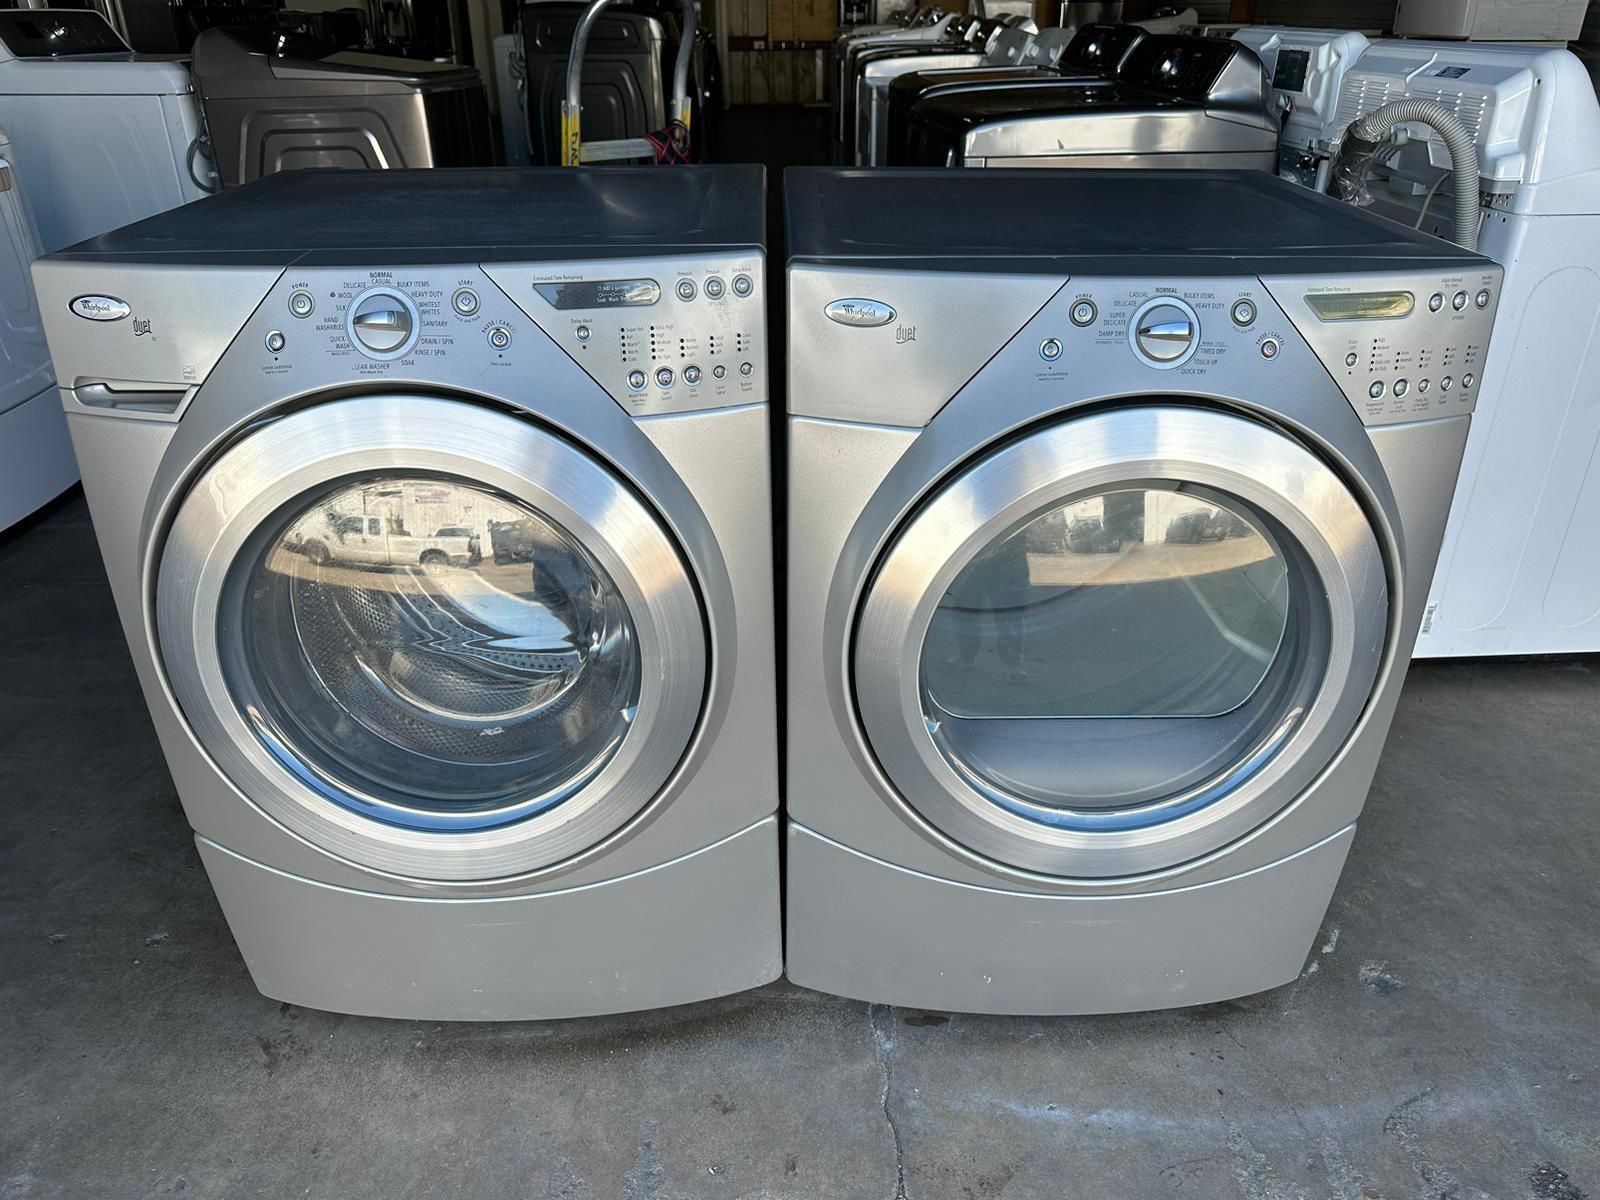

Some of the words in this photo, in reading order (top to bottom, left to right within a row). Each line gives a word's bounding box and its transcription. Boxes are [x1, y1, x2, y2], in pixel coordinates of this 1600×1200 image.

[133, 317, 152, 337] duet
[482, 320, 494, 334] PAUSE
[896, 324, 917, 344] duet
